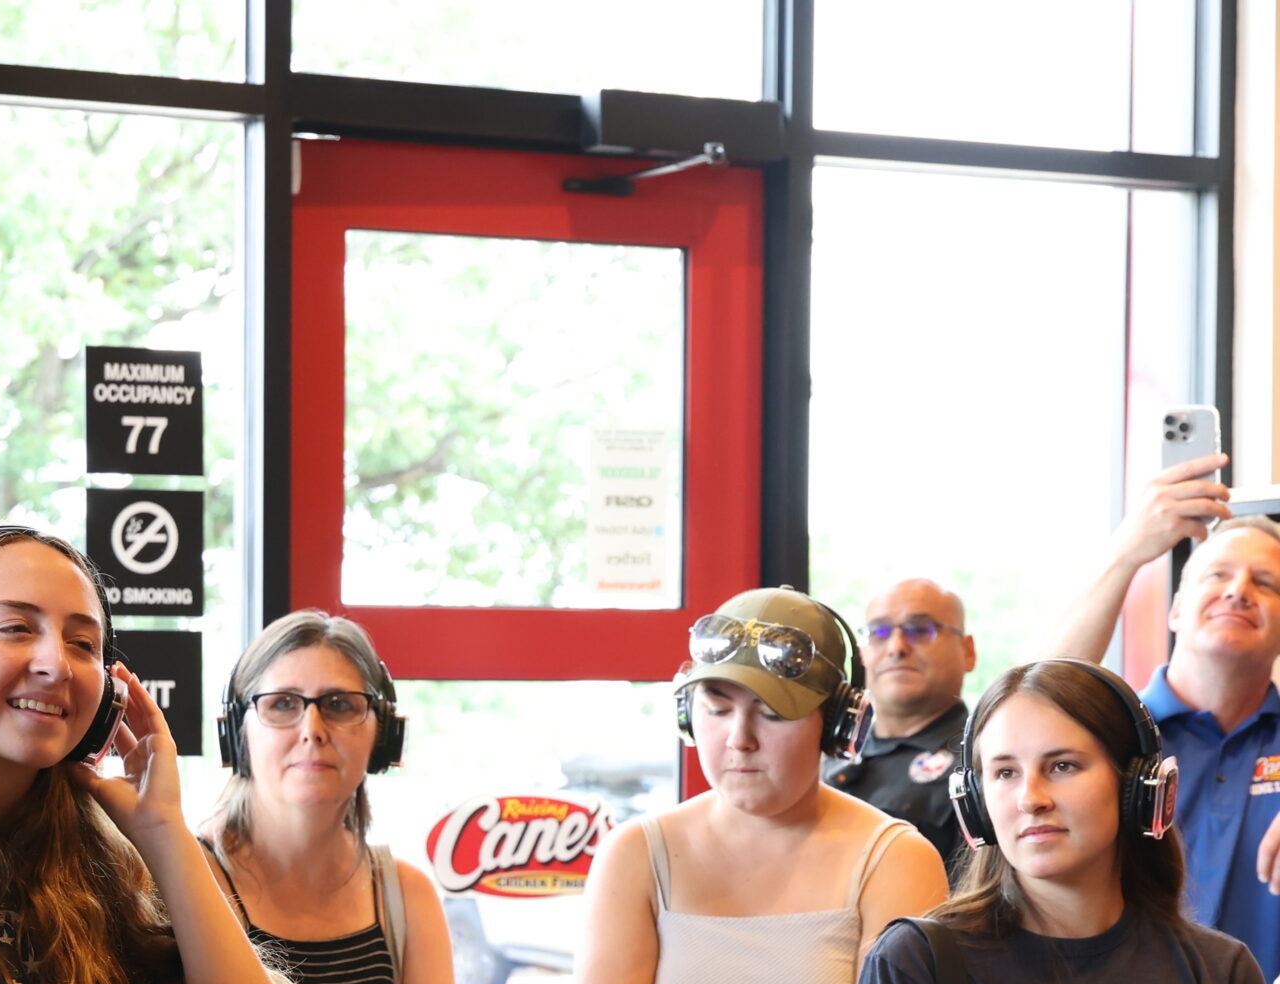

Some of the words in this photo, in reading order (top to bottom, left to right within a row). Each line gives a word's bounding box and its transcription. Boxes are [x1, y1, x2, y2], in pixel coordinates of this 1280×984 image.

[104, 362, 185, 383] MAXIMUM
[93, 383, 196, 406] OCCUPANCY
[121, 416, 168, 455] 77
[122, 588, 194, 605] SMOKING
[141, 679, 176, 709] IT
[502, 798, 569, 821] Raising
[433, 794, 614, 892] Cane's
